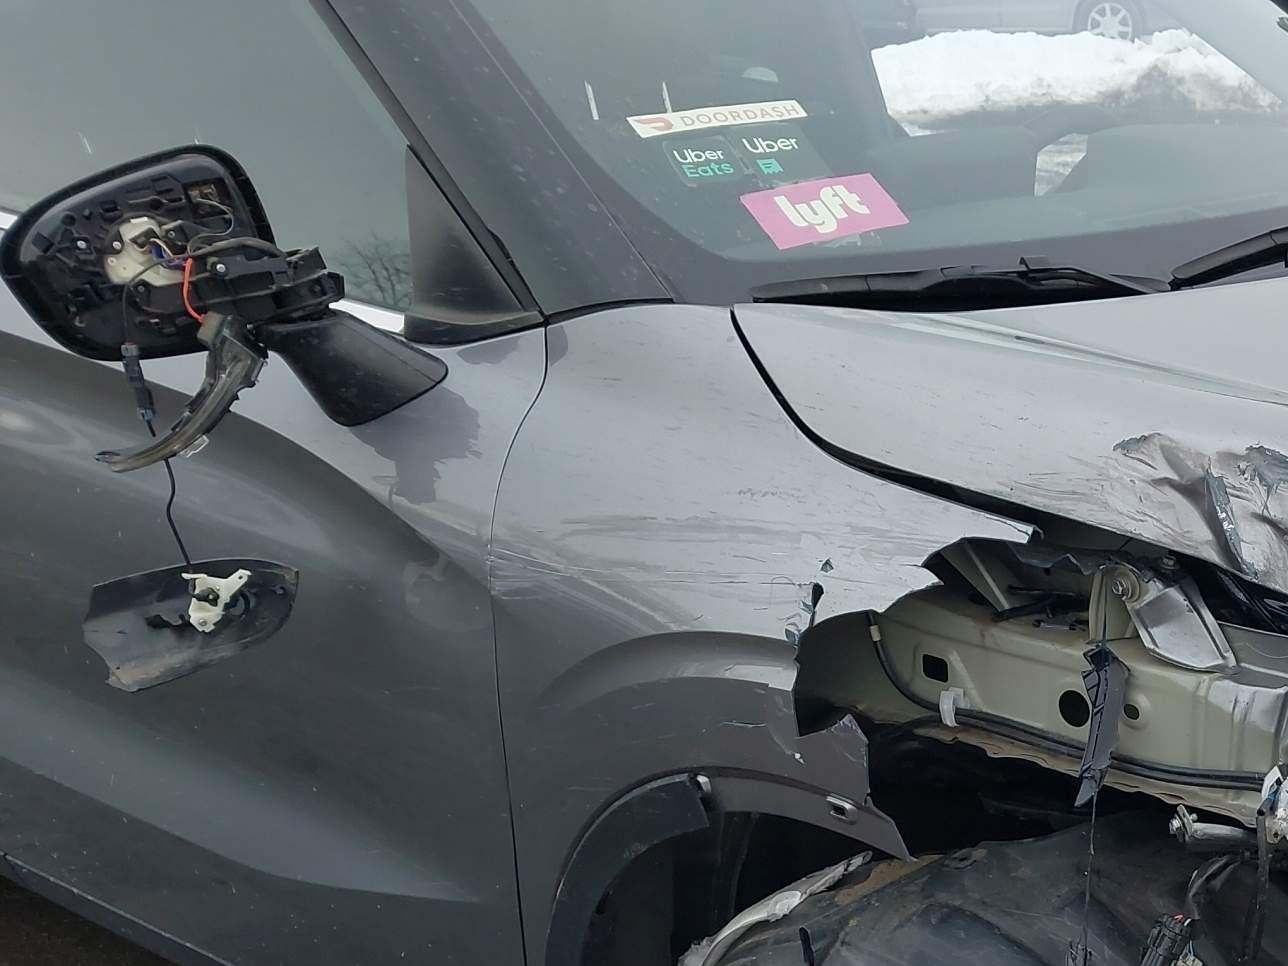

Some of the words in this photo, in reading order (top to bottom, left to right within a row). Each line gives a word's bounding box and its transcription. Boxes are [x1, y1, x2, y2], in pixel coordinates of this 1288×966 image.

[680, 105, 800, 128] DOORDASH
[742, 136, 800, 153] Uber
[673, 148, 725, 164] Uber
[682, 160, 735, 178] Eats
[773, 185, 871, 234] lyft
